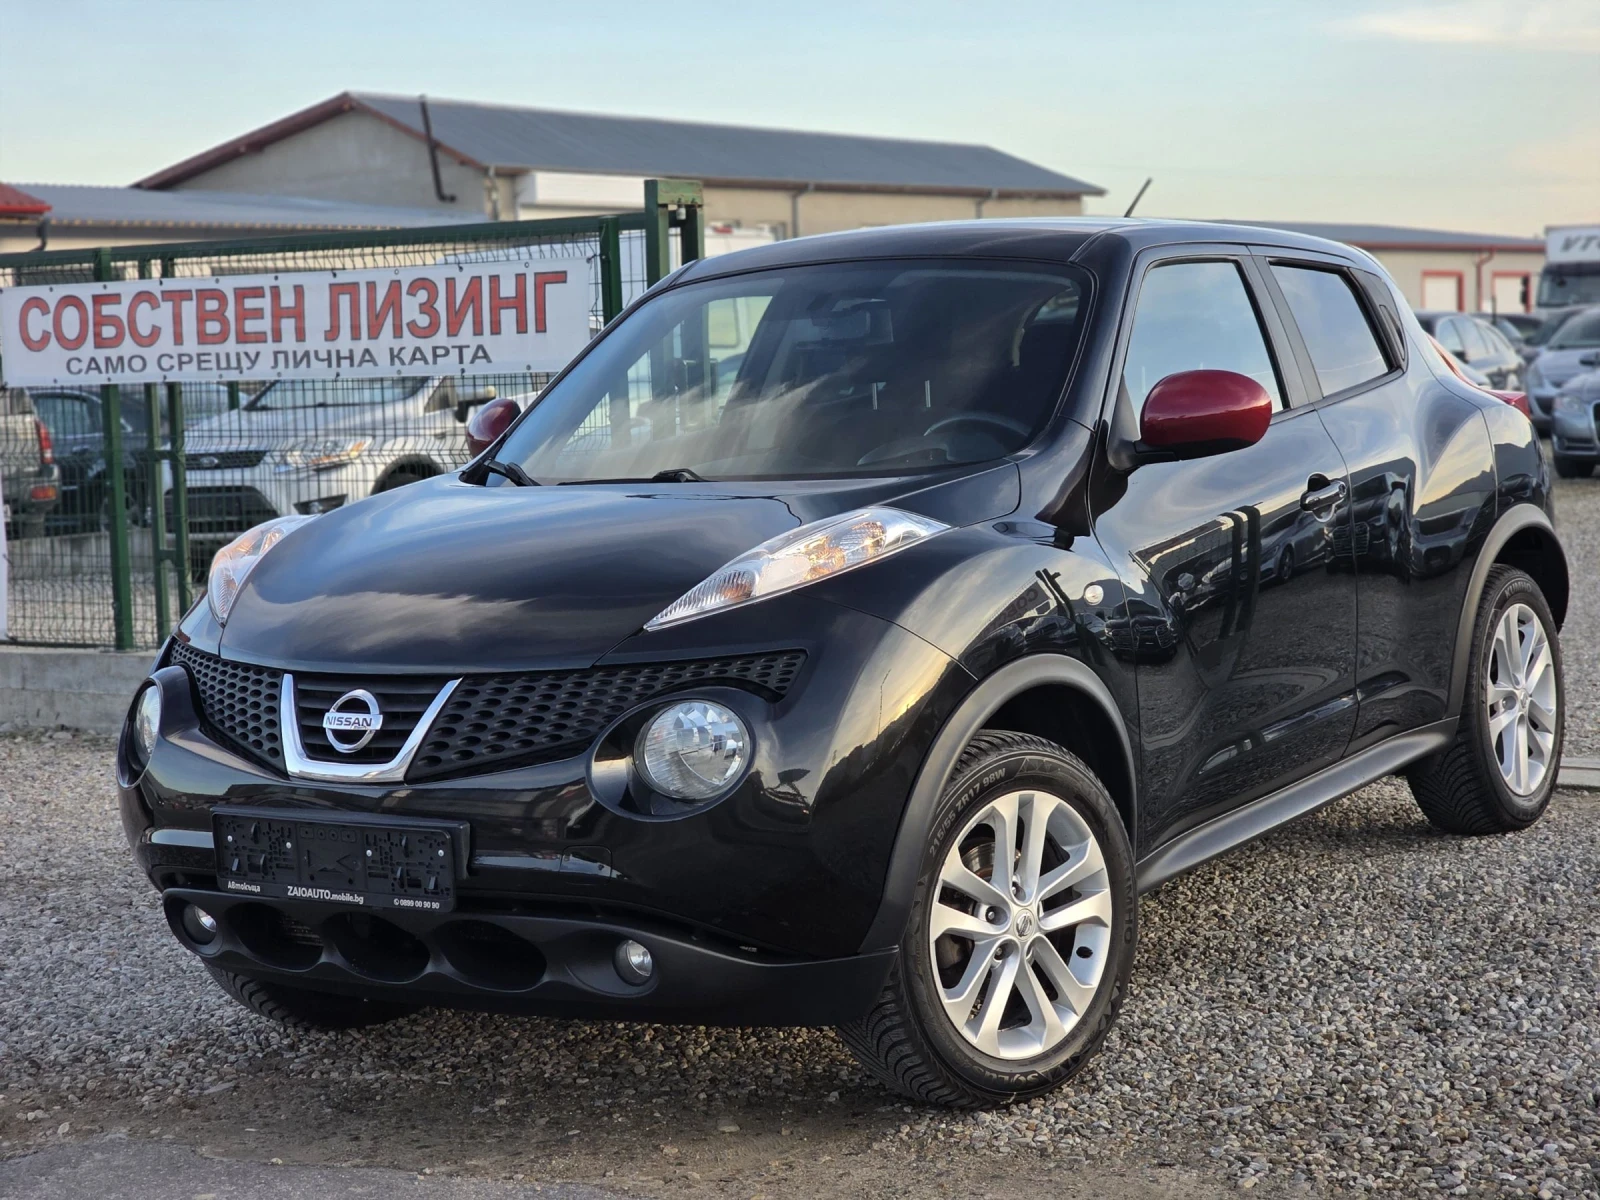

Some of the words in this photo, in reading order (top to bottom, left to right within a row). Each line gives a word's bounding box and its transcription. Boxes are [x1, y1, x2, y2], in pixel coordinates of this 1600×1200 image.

[1559, 234, 1600, 252] VT
[19, 284, 306, 352] СОБСТВЕН
[324, 270, 568, 342] ЛИЗИНГ
[65, 354, 148, 375] САМО
[157, 351, 261, 374] СРЕЩУ
[271, 347, 378, 369] ЛИЧНА
[389, 344, 492, 366] КАРТА
[325, 715, 373, 727] NISSAN
[929, 810, 956, 857] 215/55
[955, 783, 980, 811] ZR17
[982, 767, 1006, 787] 98W
[415, 900, 423, 908] 00
